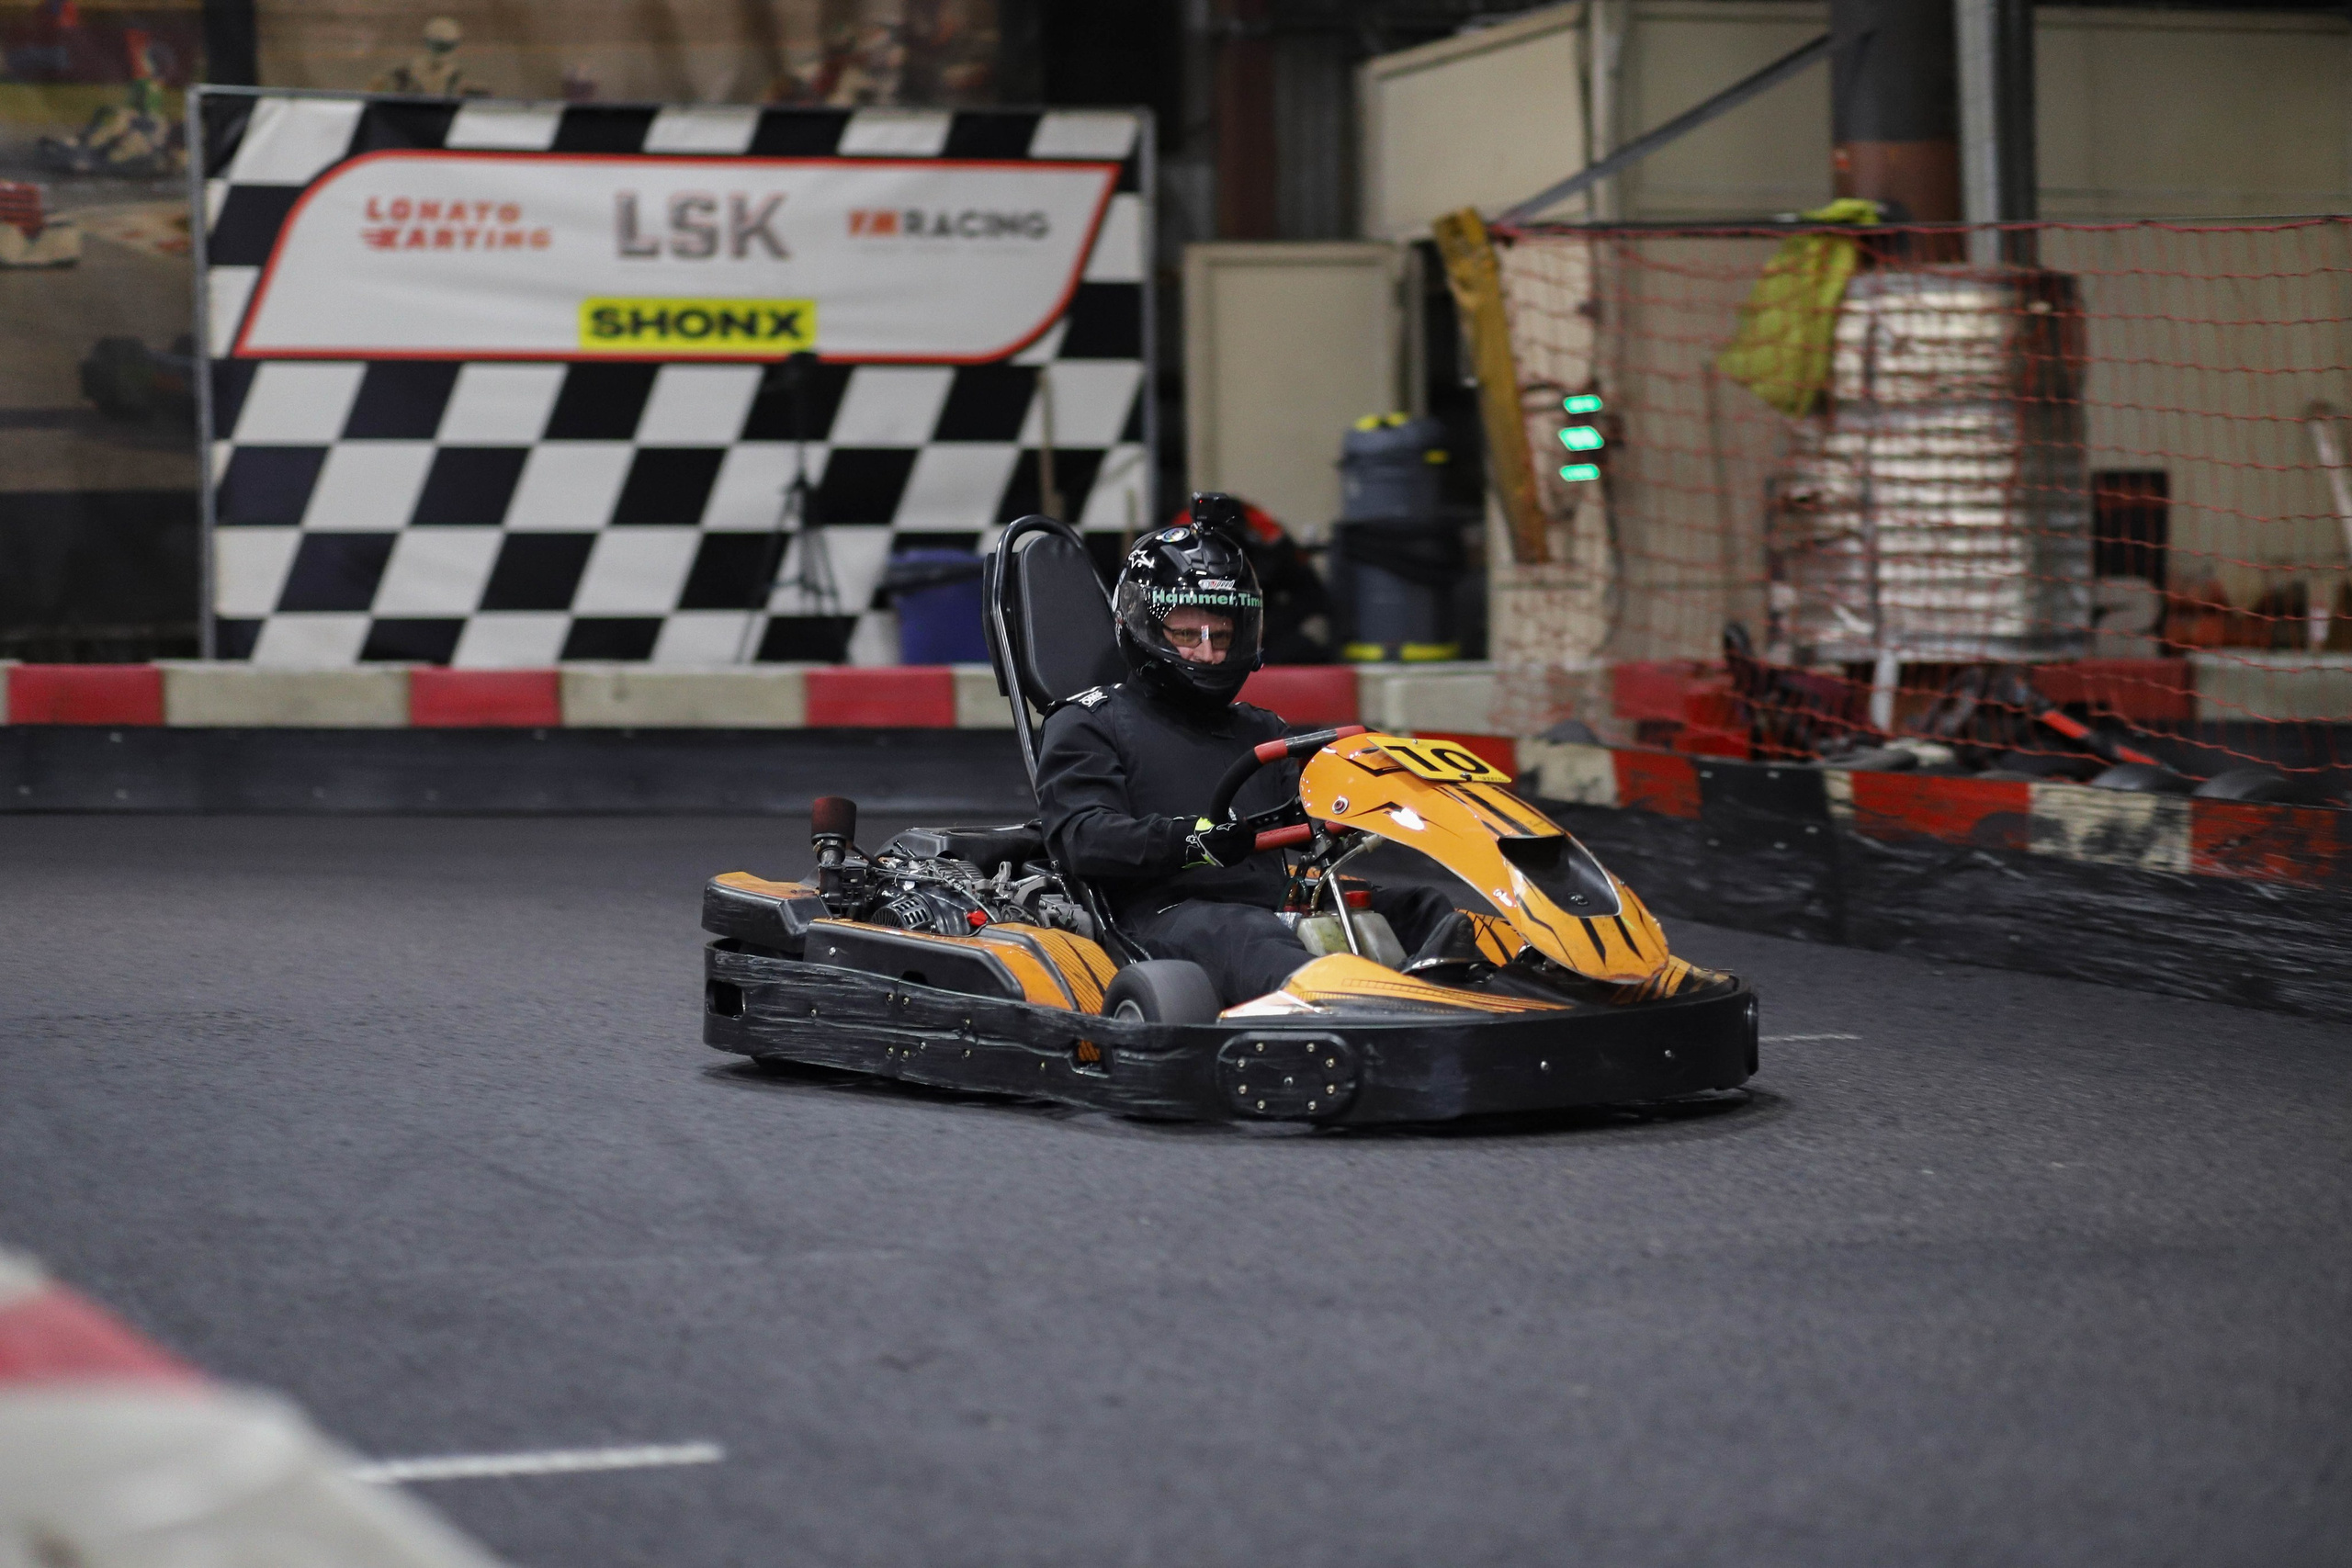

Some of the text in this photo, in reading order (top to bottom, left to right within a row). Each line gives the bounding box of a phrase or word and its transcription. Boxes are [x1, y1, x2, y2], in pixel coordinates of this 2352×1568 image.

[365, 197, 523, 224] LONATO
[614, 190, 791, 260] LSK
[590, 307, 803, 340] SHONX
[1384, 745, 1489, 773] 10
